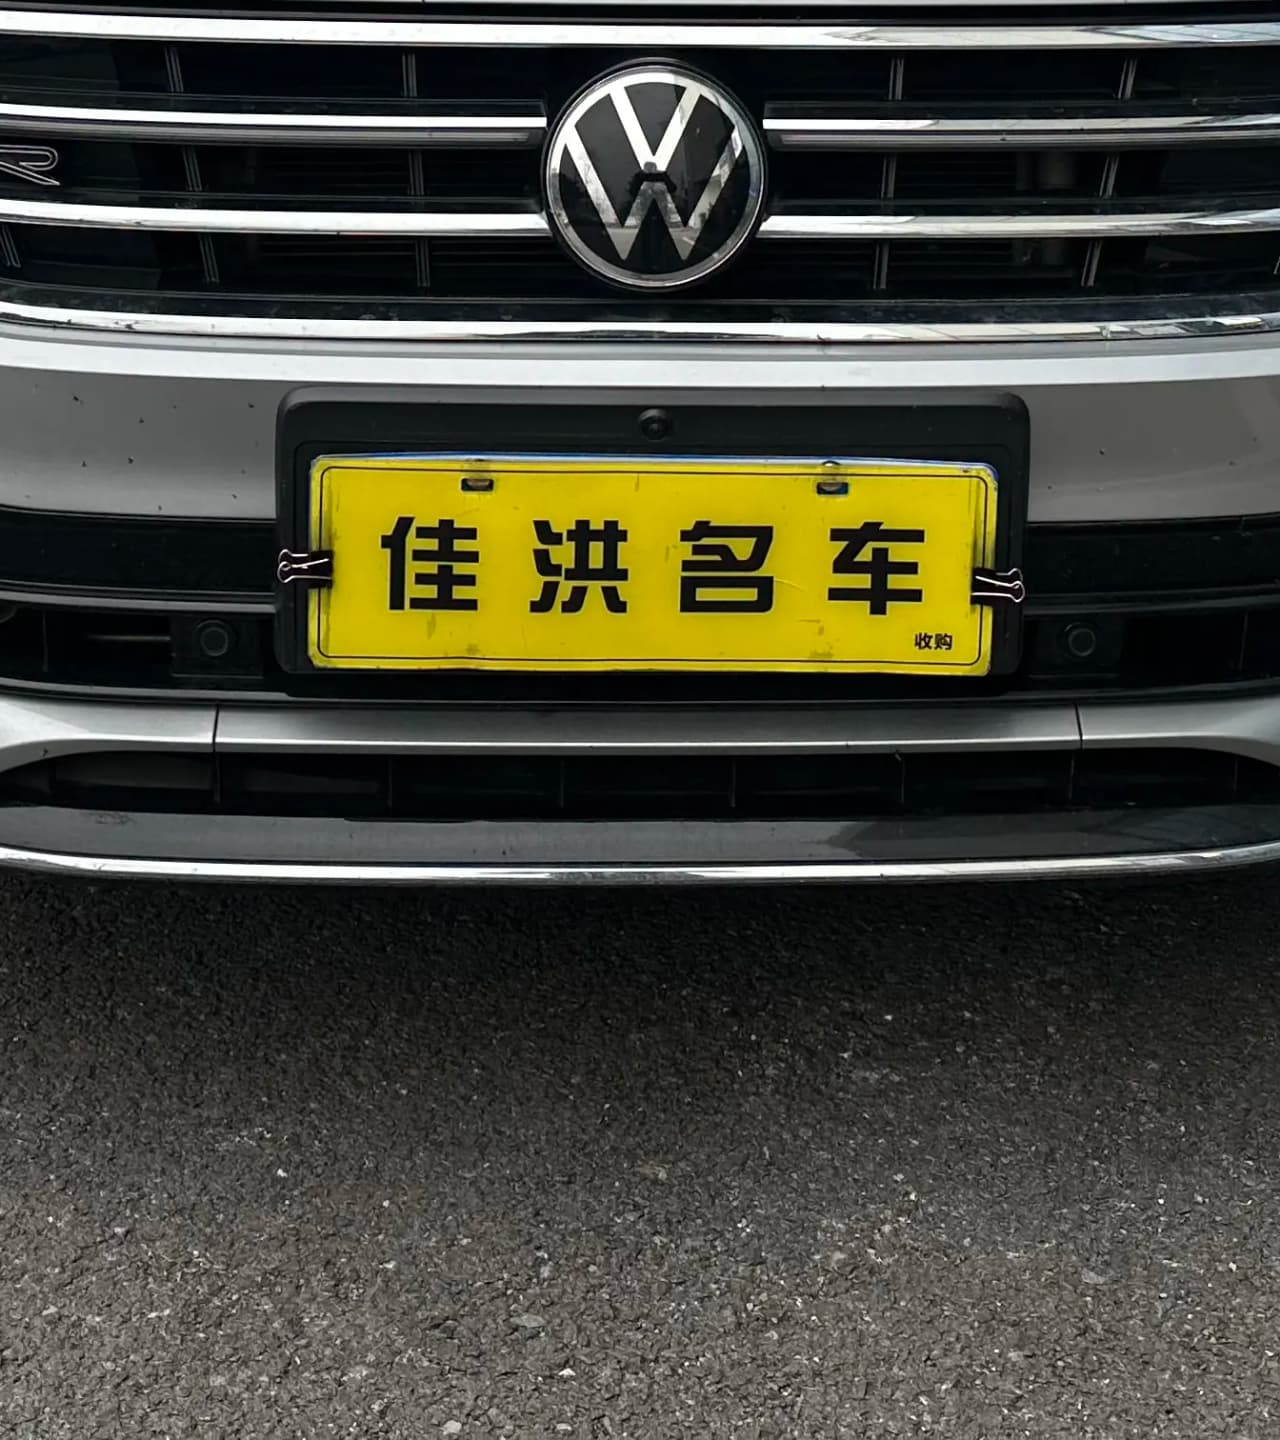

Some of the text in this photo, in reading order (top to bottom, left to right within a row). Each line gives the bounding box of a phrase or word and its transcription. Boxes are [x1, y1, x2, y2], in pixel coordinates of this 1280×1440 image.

[380, 516, 925, 616] 佳洪名车
[914, 632, 953, 650] 收购
